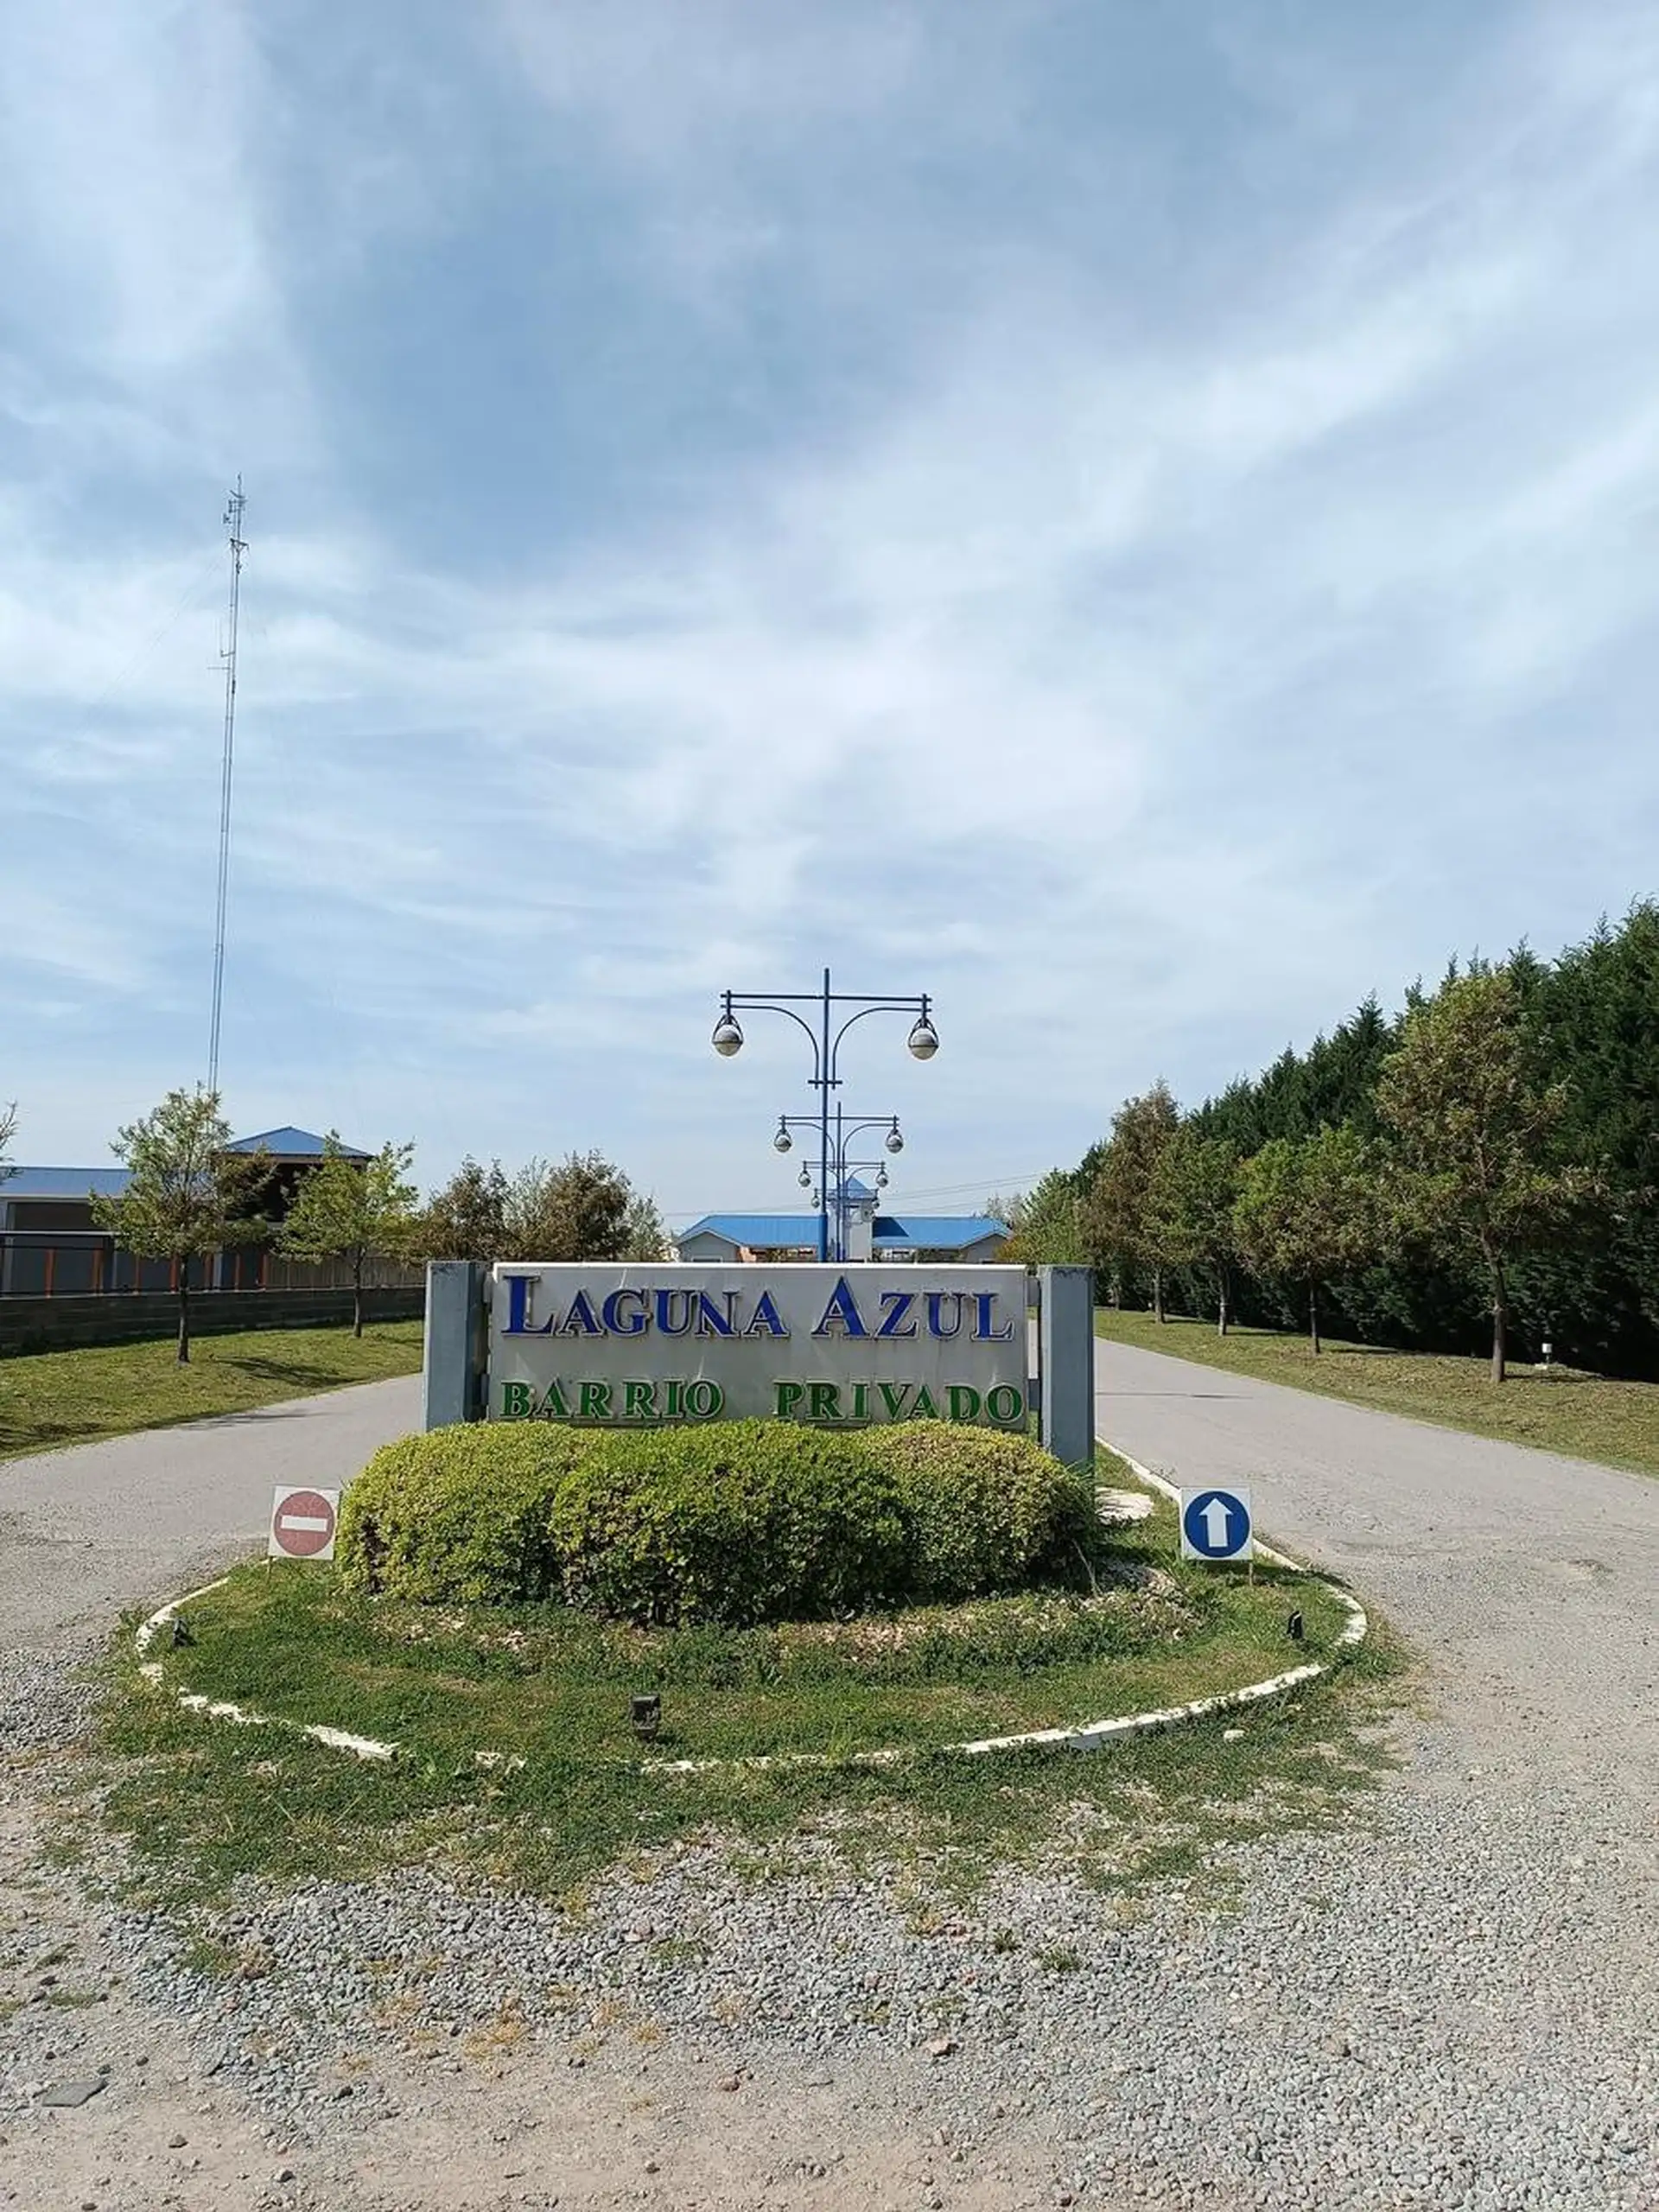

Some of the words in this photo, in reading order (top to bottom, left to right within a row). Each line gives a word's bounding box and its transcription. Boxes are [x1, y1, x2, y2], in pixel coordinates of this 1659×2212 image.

[501, 1274, 790, 1338] LAGUNA
[810, 1274, 1014, 1341] AZUL
[499, 1380, 724, 1420] BARRIO
[773, 1380, 1026, 1423] PRIVADO
